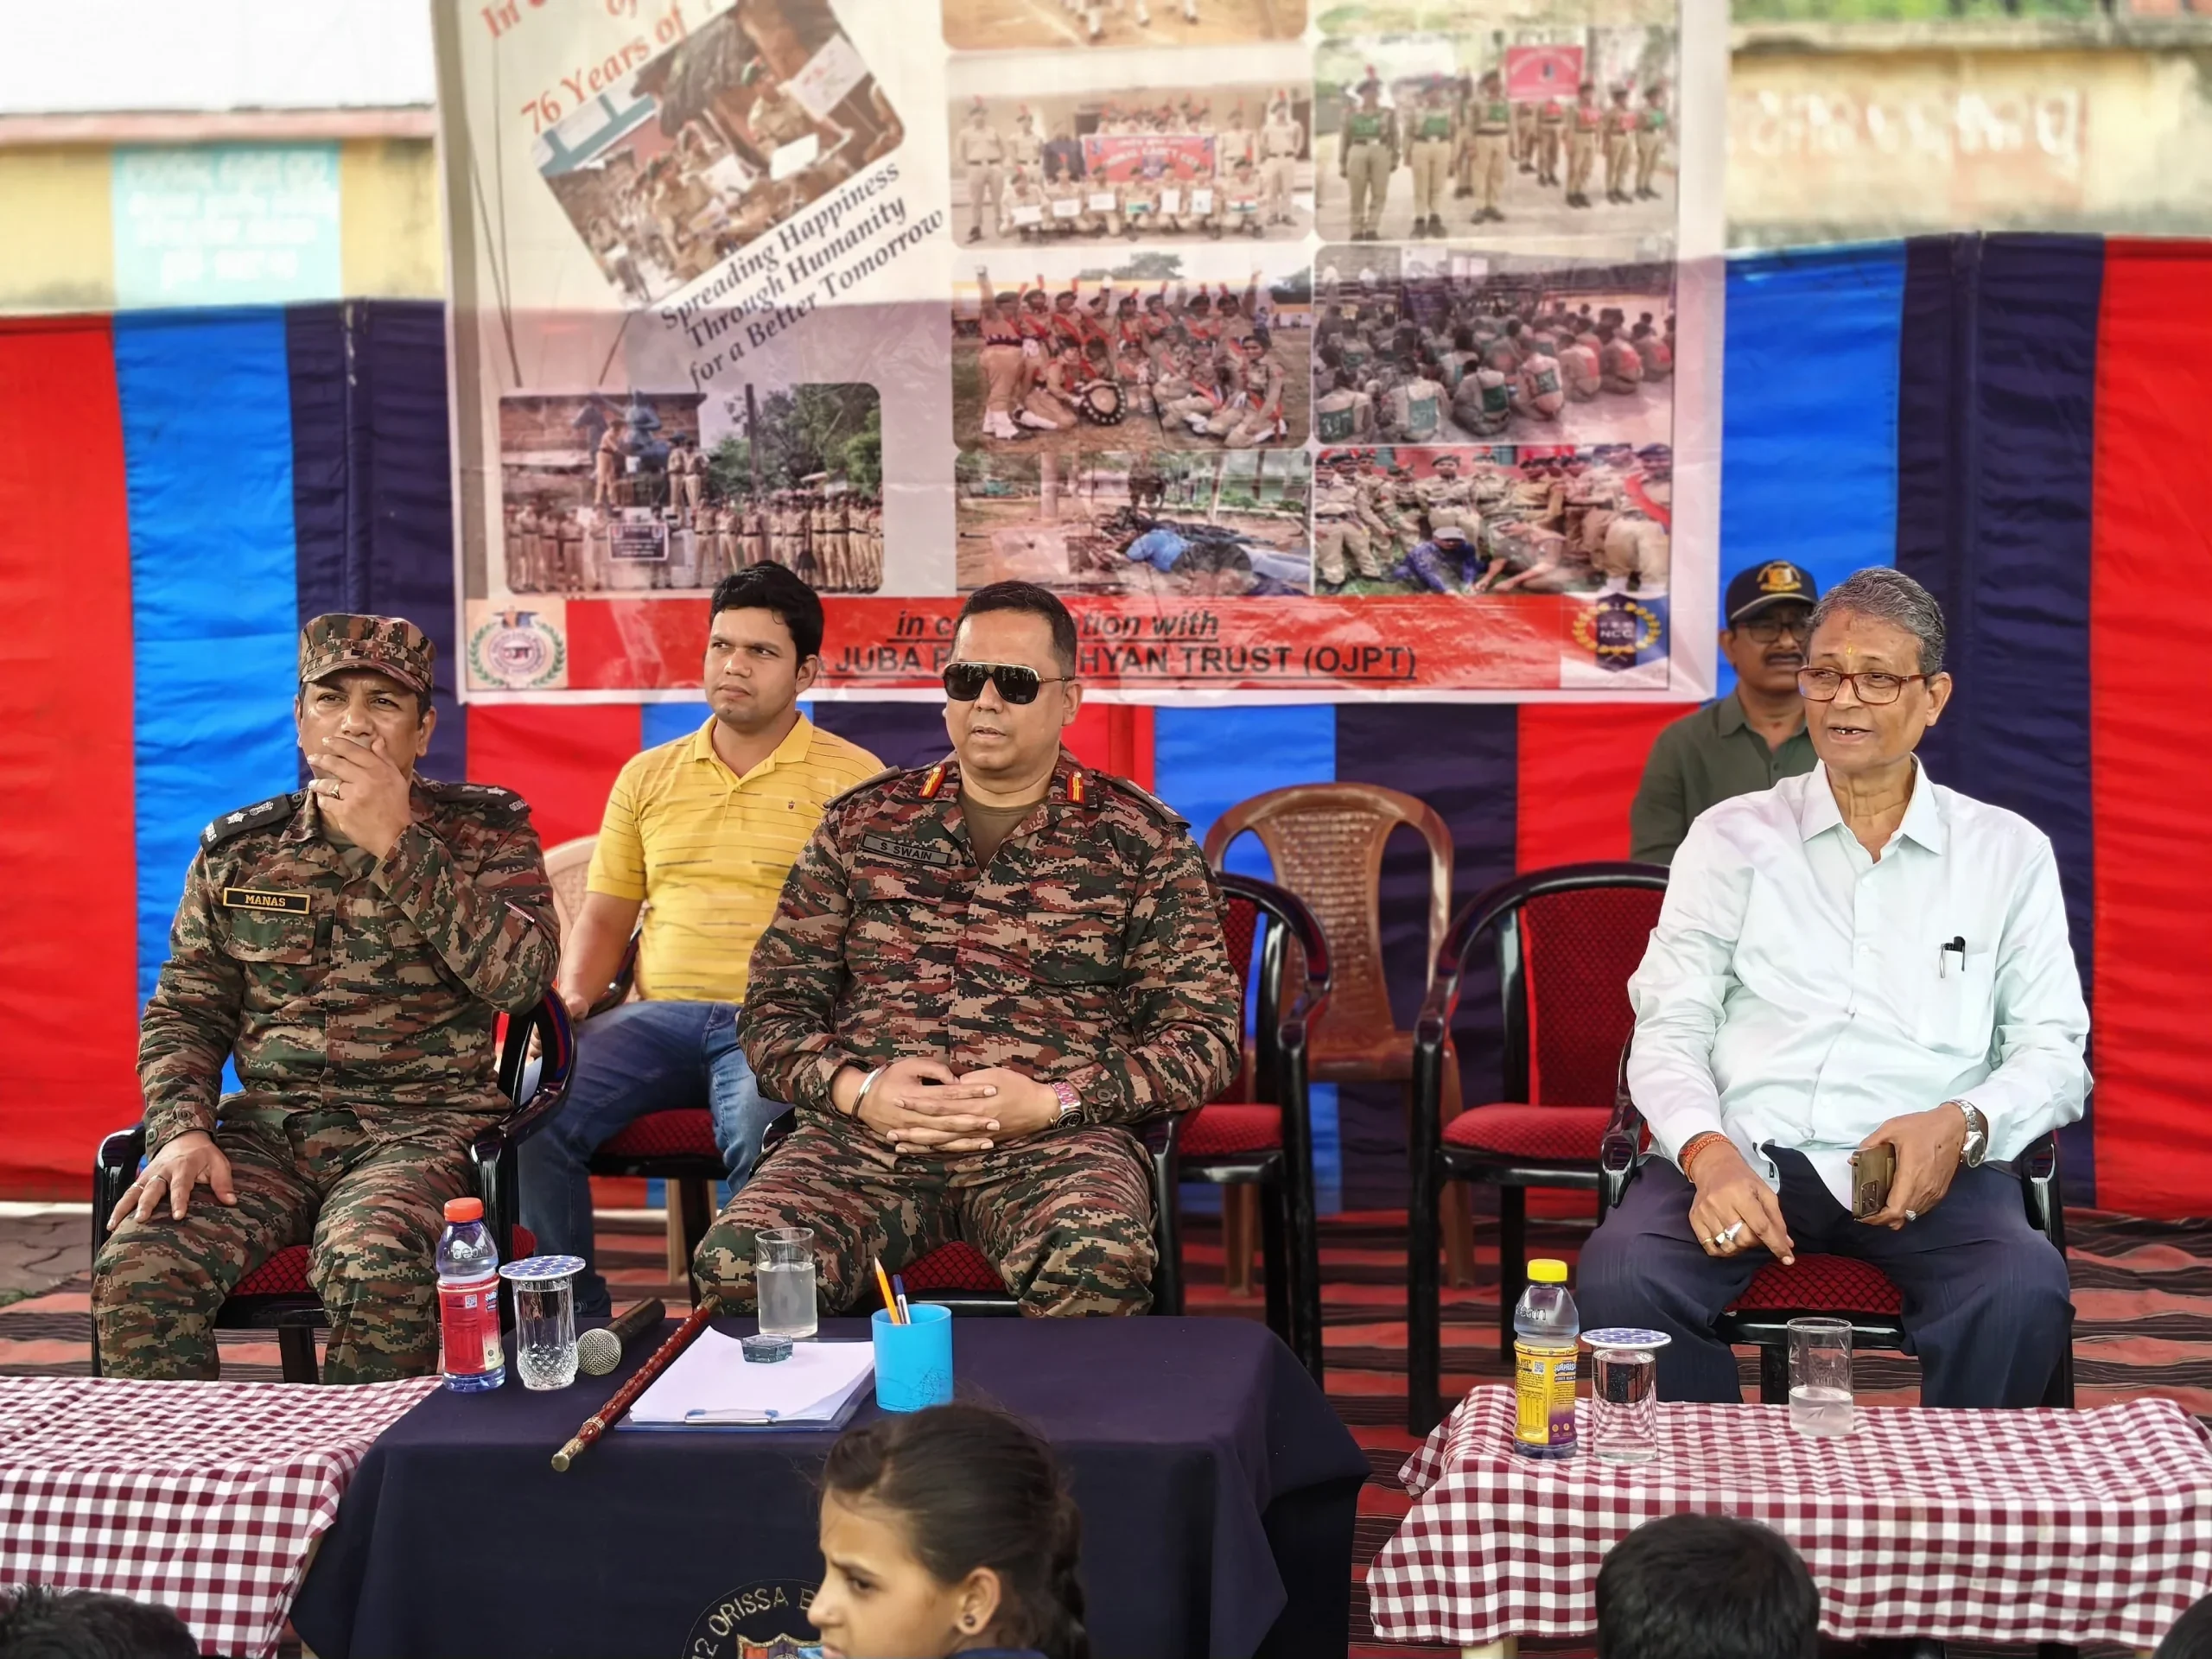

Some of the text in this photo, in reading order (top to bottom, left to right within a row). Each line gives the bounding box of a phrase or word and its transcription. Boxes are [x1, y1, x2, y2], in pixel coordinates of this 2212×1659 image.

[520, 0, 688, 134] 76 Years of
[660, 162, 900, 334] Spreading Happiness
[684, 196, 907, 348] Through Humanity
[688, 209, 945, 392] for a Better Tomorrow
[896, 610, 925, 637] in
[1152, 609, 1219, 637] with
[1599, 629, 1634, 639] NCC
[836, 645, 918, 673] JUBA
[1181, 645, 1294, 673] TRUST
[1303, 645, 1416, 679] (OJPT)
[880, 842, 932, 861] S SWAIN
[245, 894, 286, 907] MANAS
[708, 1586, 789, 1637] ORISSA
